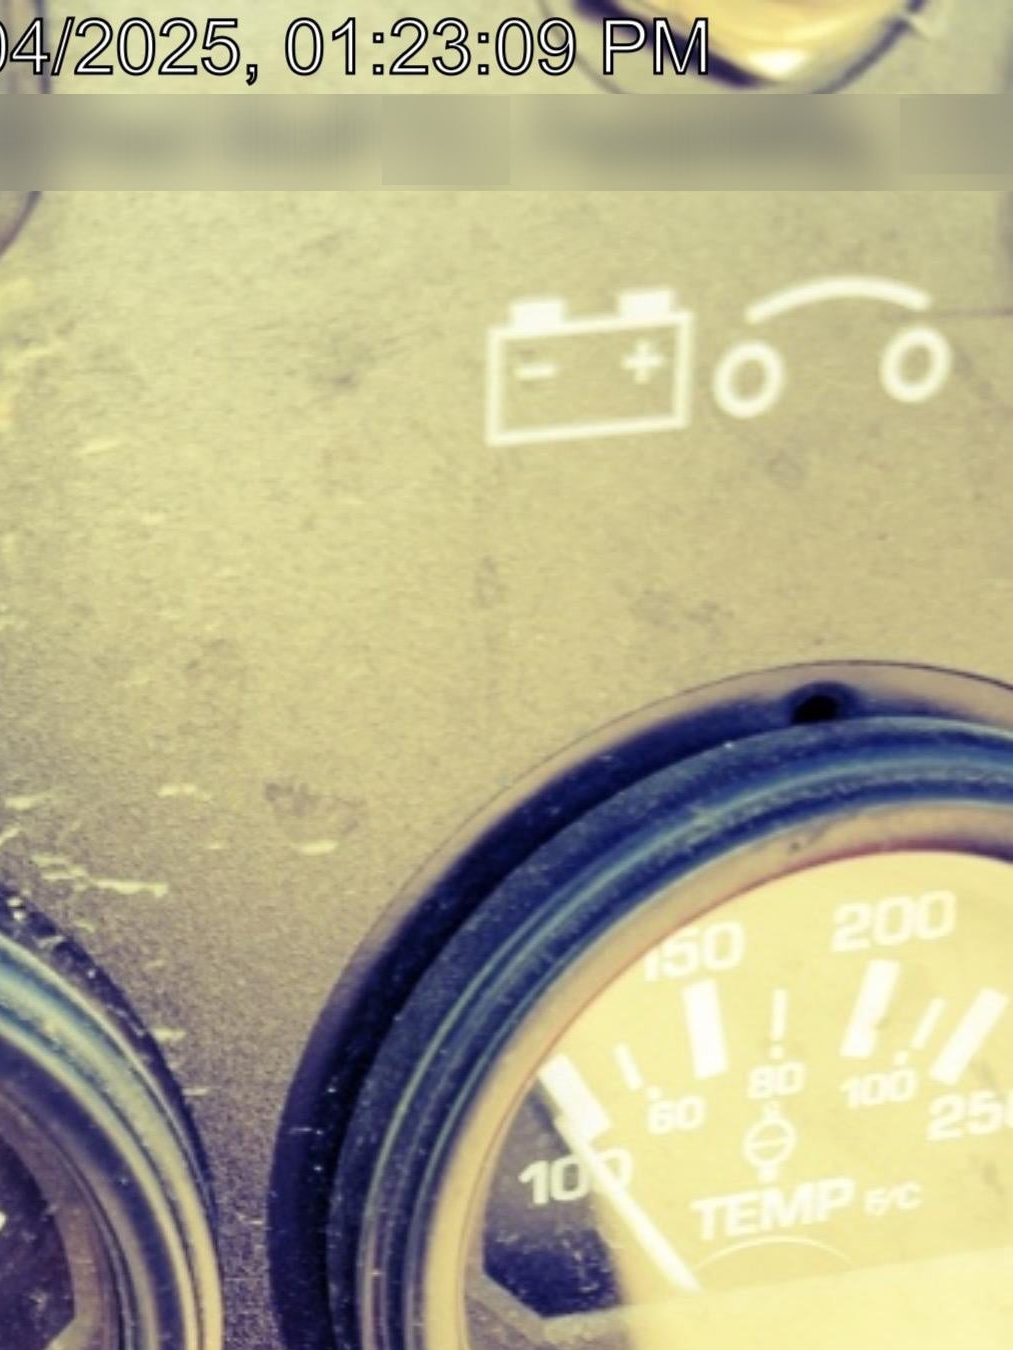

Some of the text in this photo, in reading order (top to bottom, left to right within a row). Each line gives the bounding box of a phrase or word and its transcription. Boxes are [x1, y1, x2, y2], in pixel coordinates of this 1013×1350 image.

[830, 890, 957, 954] 200
[643, 921, 746, 983] 150
[746, 1060, 806, 1100] 80
[839, 1067, 918, 1109] 100
[645, 1096, 706, 1136] 60
[925, 1088, 1013, 1141] 25
[517, 1147, 635, 1207] 100
[690, 1176, 856, 1242] TEMP
